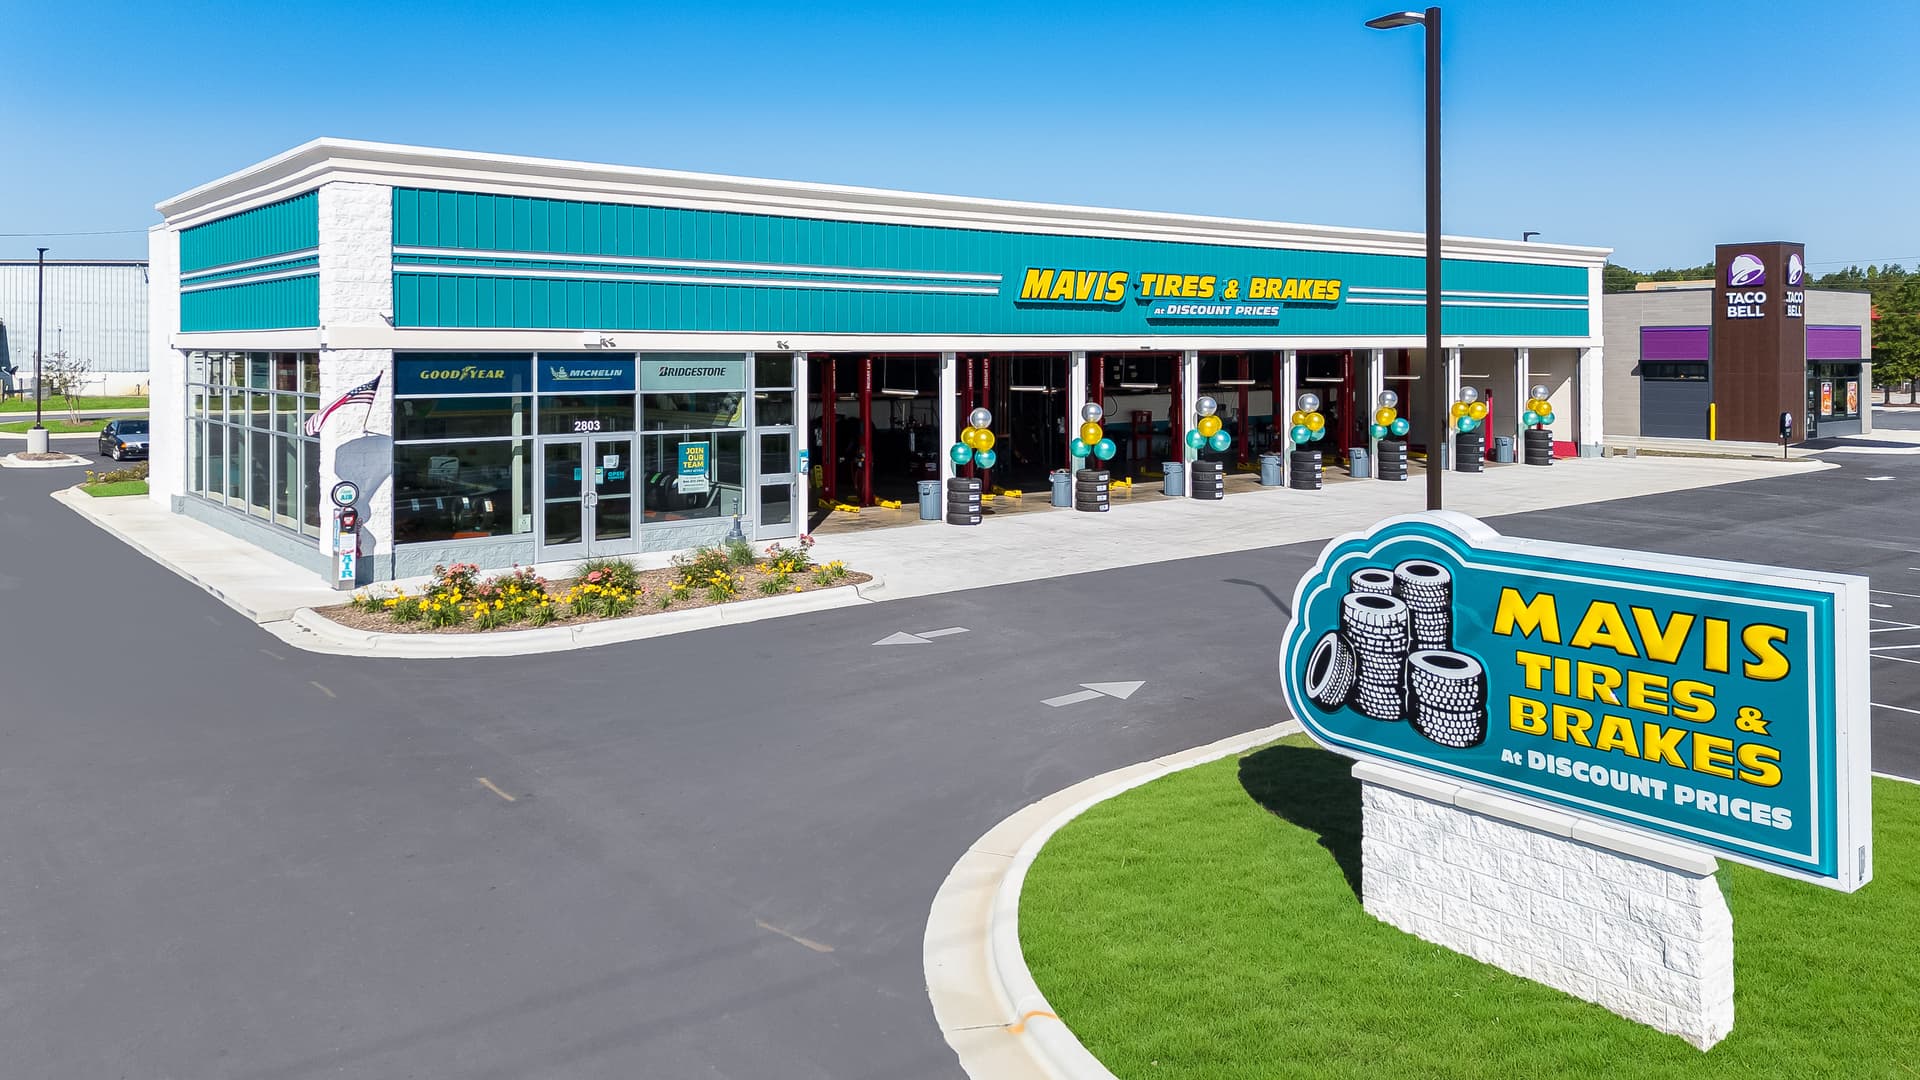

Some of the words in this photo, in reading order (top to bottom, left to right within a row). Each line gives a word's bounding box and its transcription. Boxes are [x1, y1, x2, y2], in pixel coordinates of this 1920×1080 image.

[1020, 268, 1129, 302] MAVIS
[1140, 273, 1217, 298] TIRES
[1223, 279, 1239, 299] &
[1248, 277, 1341, 301] BRAKES
[1726, 291, 1767, 304] TACO
[1786, 291, 1803, 303] TACO
[1167, 305, 1232, 315] DISCOUNT
[1235, 306, 1279, 316] PRICES
[1727, 305, 1765, 318] BELL
[1787, 305, 1803, 317] BELL
[420, 365, 505, 381] GOODYEAR
[569, 369, 623, 377] MICHELIN
[658, 366, 726, 377] BRIDGESTONE
[574, 420, 601, 432] 2803
[685, 447, 704, 455] JOIN
[682, 461, 704, 469] TEAM
[341, 554, 353, 578] AIR
[1492, 586, 1791, 682] MAVIS
[1515, 649, 1717, 724] TIRES
[1734, 705, 1773, 737] &
[1508, 694, 1783, 788] BRAKES
[1501, 749, 1523, 766] At
[1527, 749, 1668, 801] DISCOUNT
[1673, 783, 1793, 831] PRICES
